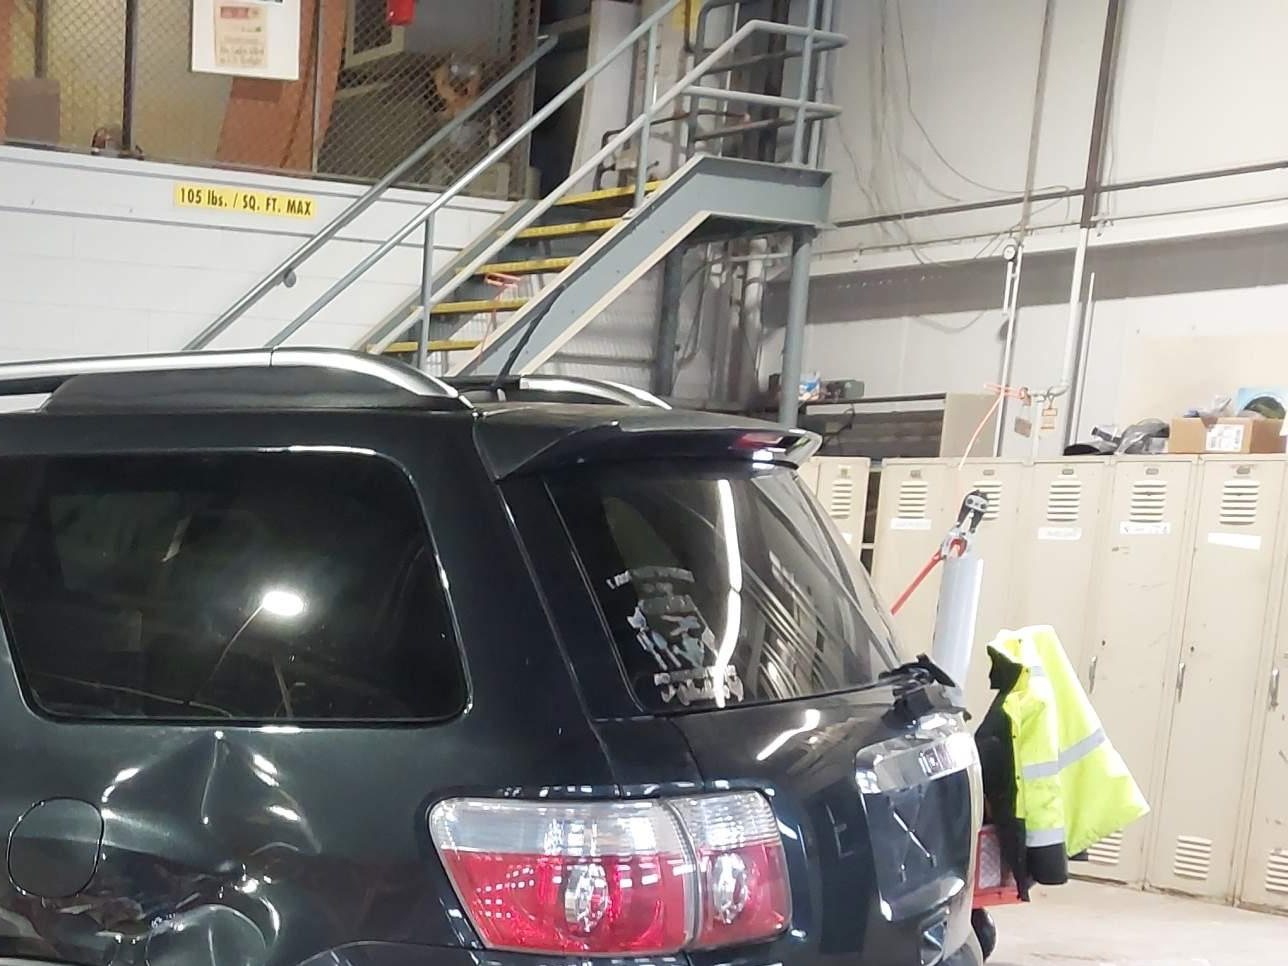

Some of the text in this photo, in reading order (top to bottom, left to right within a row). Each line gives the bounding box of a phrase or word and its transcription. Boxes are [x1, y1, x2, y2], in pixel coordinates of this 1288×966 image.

[180, 187, 312, 216] 105 lbs. / SQ. FT. MAX
